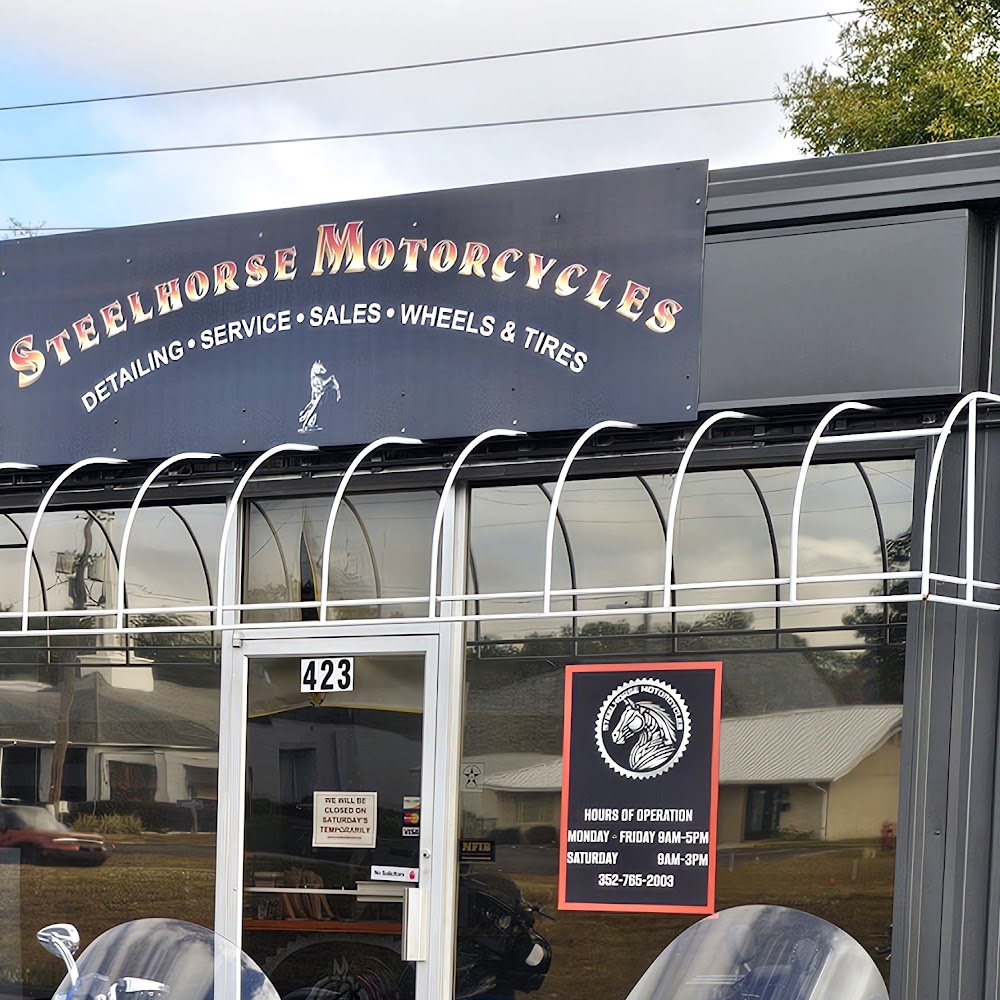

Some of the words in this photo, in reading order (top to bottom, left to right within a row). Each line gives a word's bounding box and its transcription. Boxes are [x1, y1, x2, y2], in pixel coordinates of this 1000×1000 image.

[9, 246, 297, 388] STEELHORSE
[311, 220, 683, 333] MOTORCYCLES
[81, 340, 185, 413] DETAILING
[201, 310, 291, 350] SERVICE
[309, 302, 381, 327] SALES
[400, 303, 496, 337] WHEELS
[499, 320, 516, 343] &
[523, 326, 588, 374] TIRES
[303, 659, 351, 690] 423
[584, 808, 619, 822] HOURS
[621, 808, 635, 822] OF
[636, 809, 693, 822] OPERATION
[567, 830, 610, 843] MONDAY
[619, 831, 656, 844] FRIDAY
[657, 831, 709, 845] 9AM-5PM
[566, 851, 619, 865] SATURDAY
[657, 853, 708, 866] 9AM-3PM
[598, 873, 674, 888] 352-765-2003
